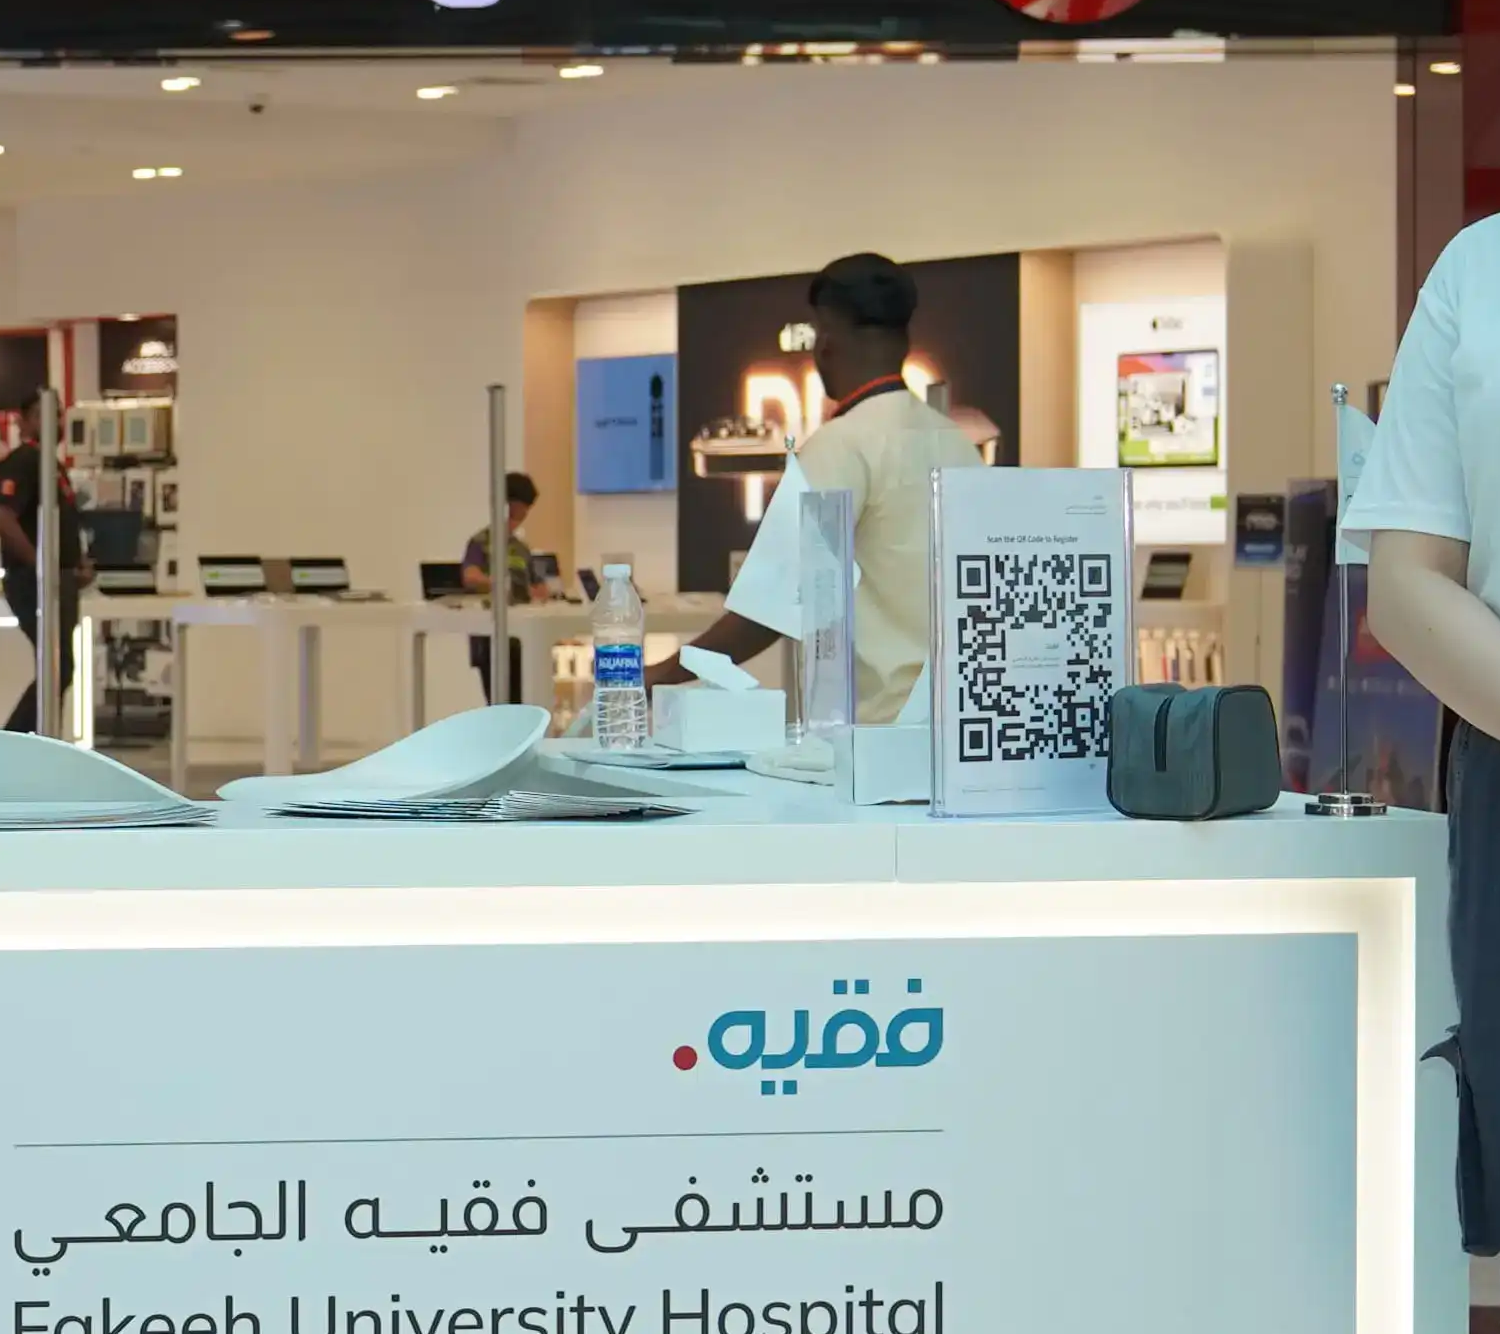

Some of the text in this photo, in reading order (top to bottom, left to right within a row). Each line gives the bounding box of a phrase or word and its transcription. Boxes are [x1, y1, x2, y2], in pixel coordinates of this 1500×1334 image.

[14, 1166, 944, 1277] مستشفى فقيه الجامعي
